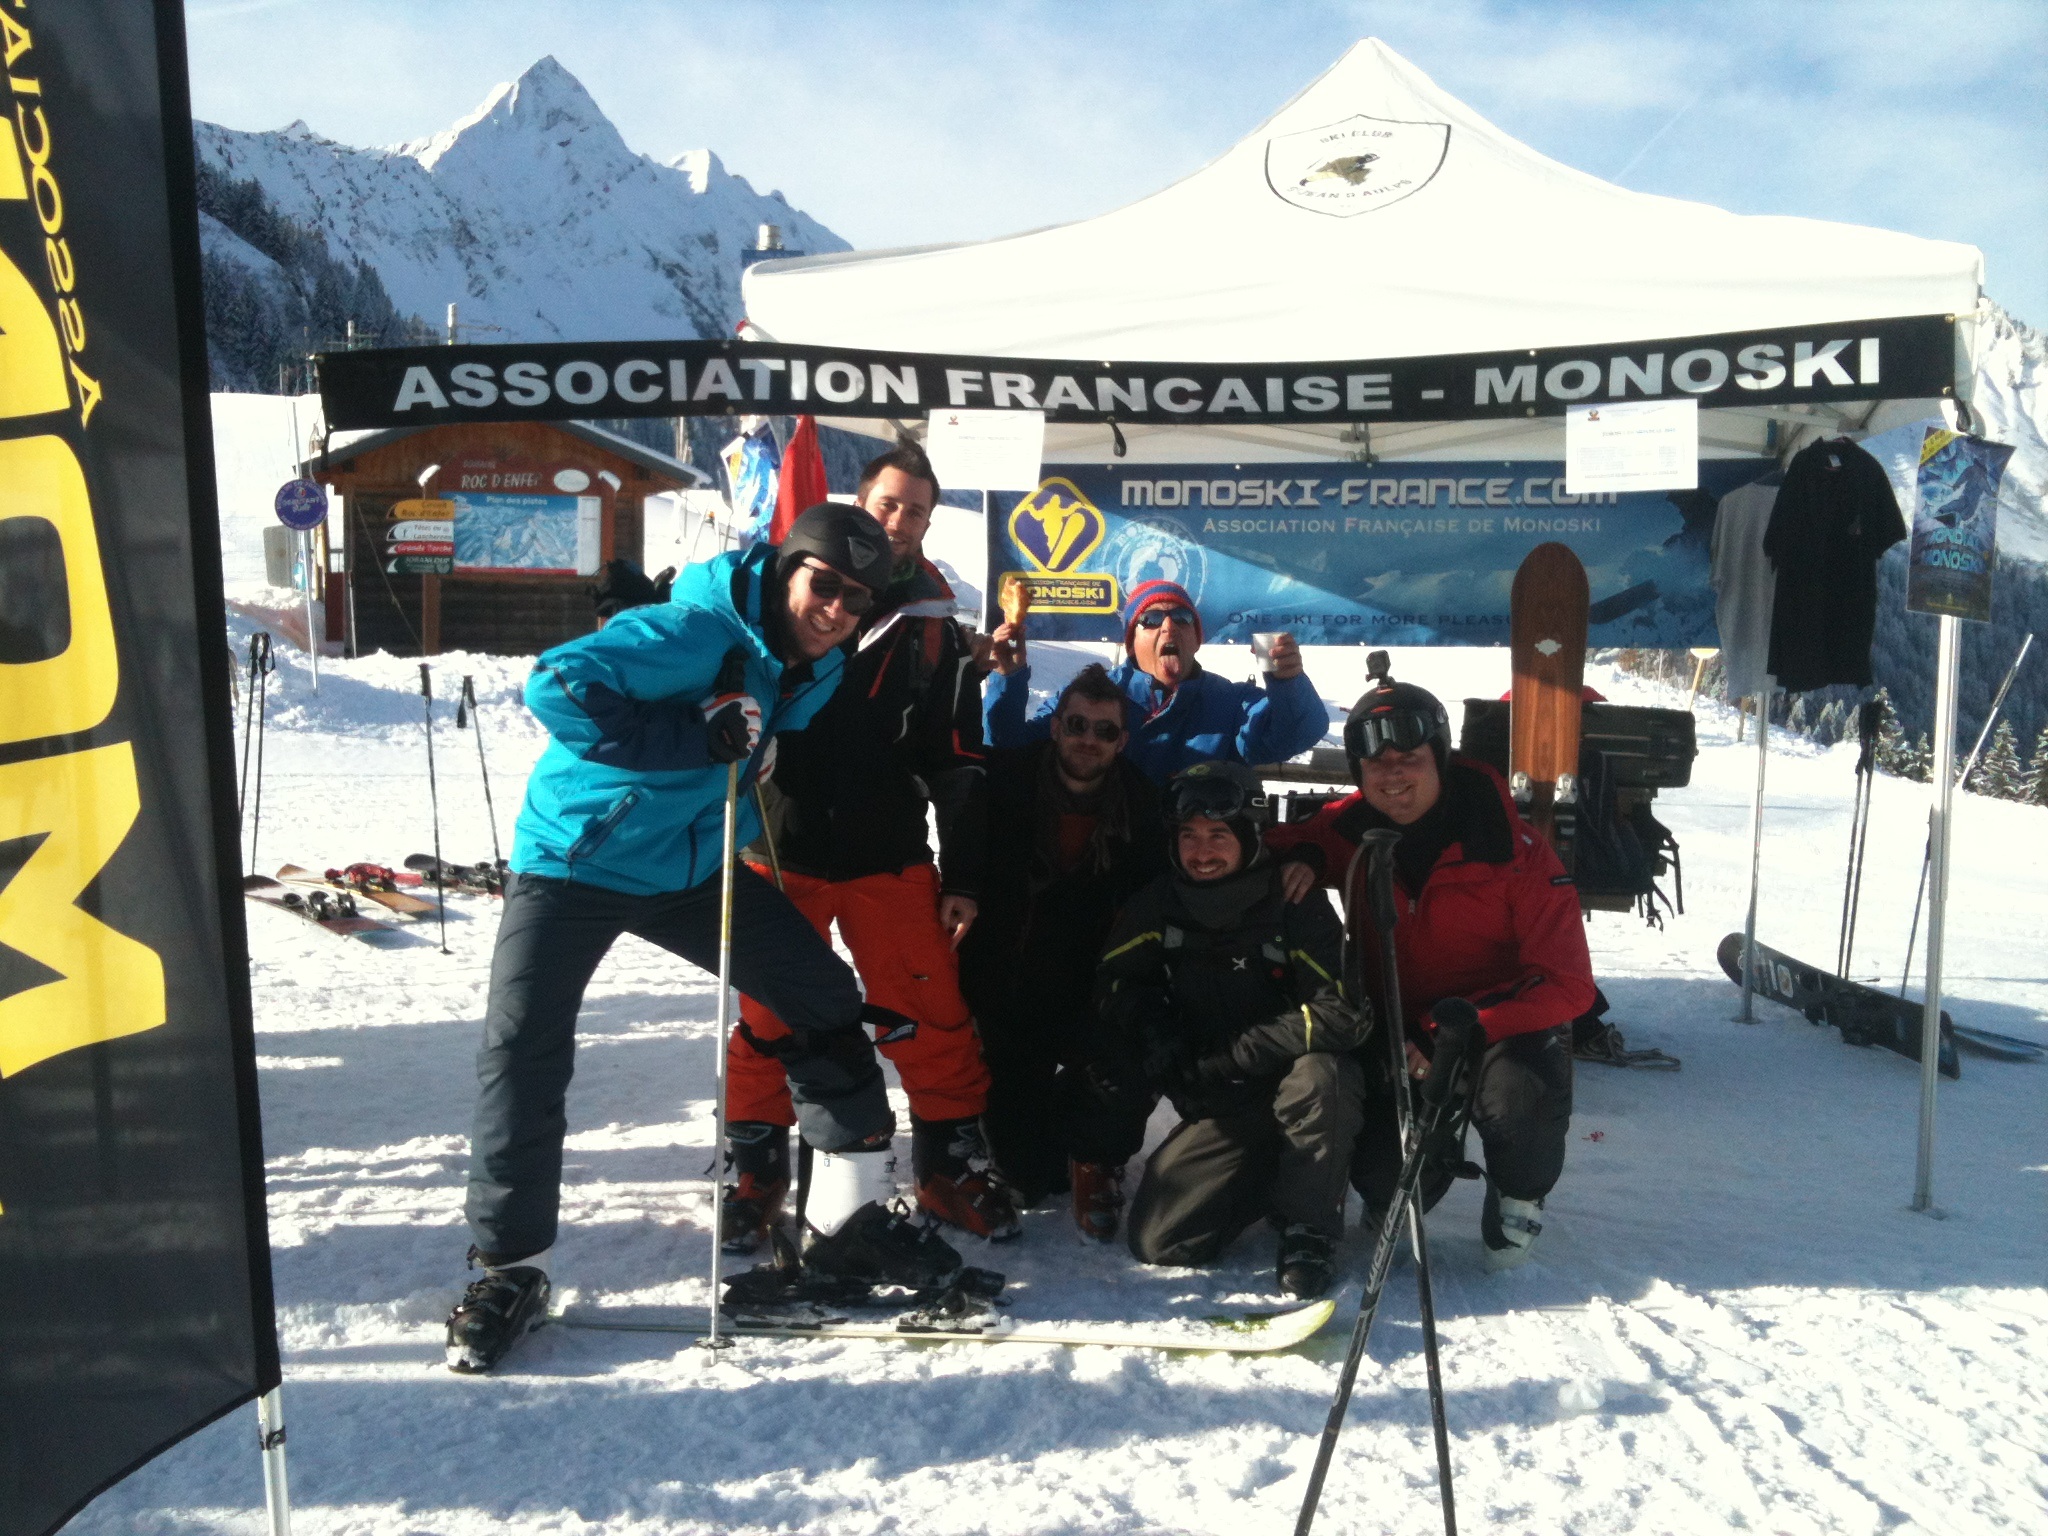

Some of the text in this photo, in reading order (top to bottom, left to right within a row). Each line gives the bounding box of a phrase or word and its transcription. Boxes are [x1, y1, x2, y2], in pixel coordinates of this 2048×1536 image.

[393, 357, 920, 412] ASSOCIATION
[945, 367, 1393, 414] FRANCAISE
[1474, 337, 1880, 406] MONOSKI
[1228, 612, 1273, 625] ONE
[1280, 614, 1312, 625] SKI
[1322, 614, 1362, 625] FOR
[1372, 615, 1430, 625] MORE
